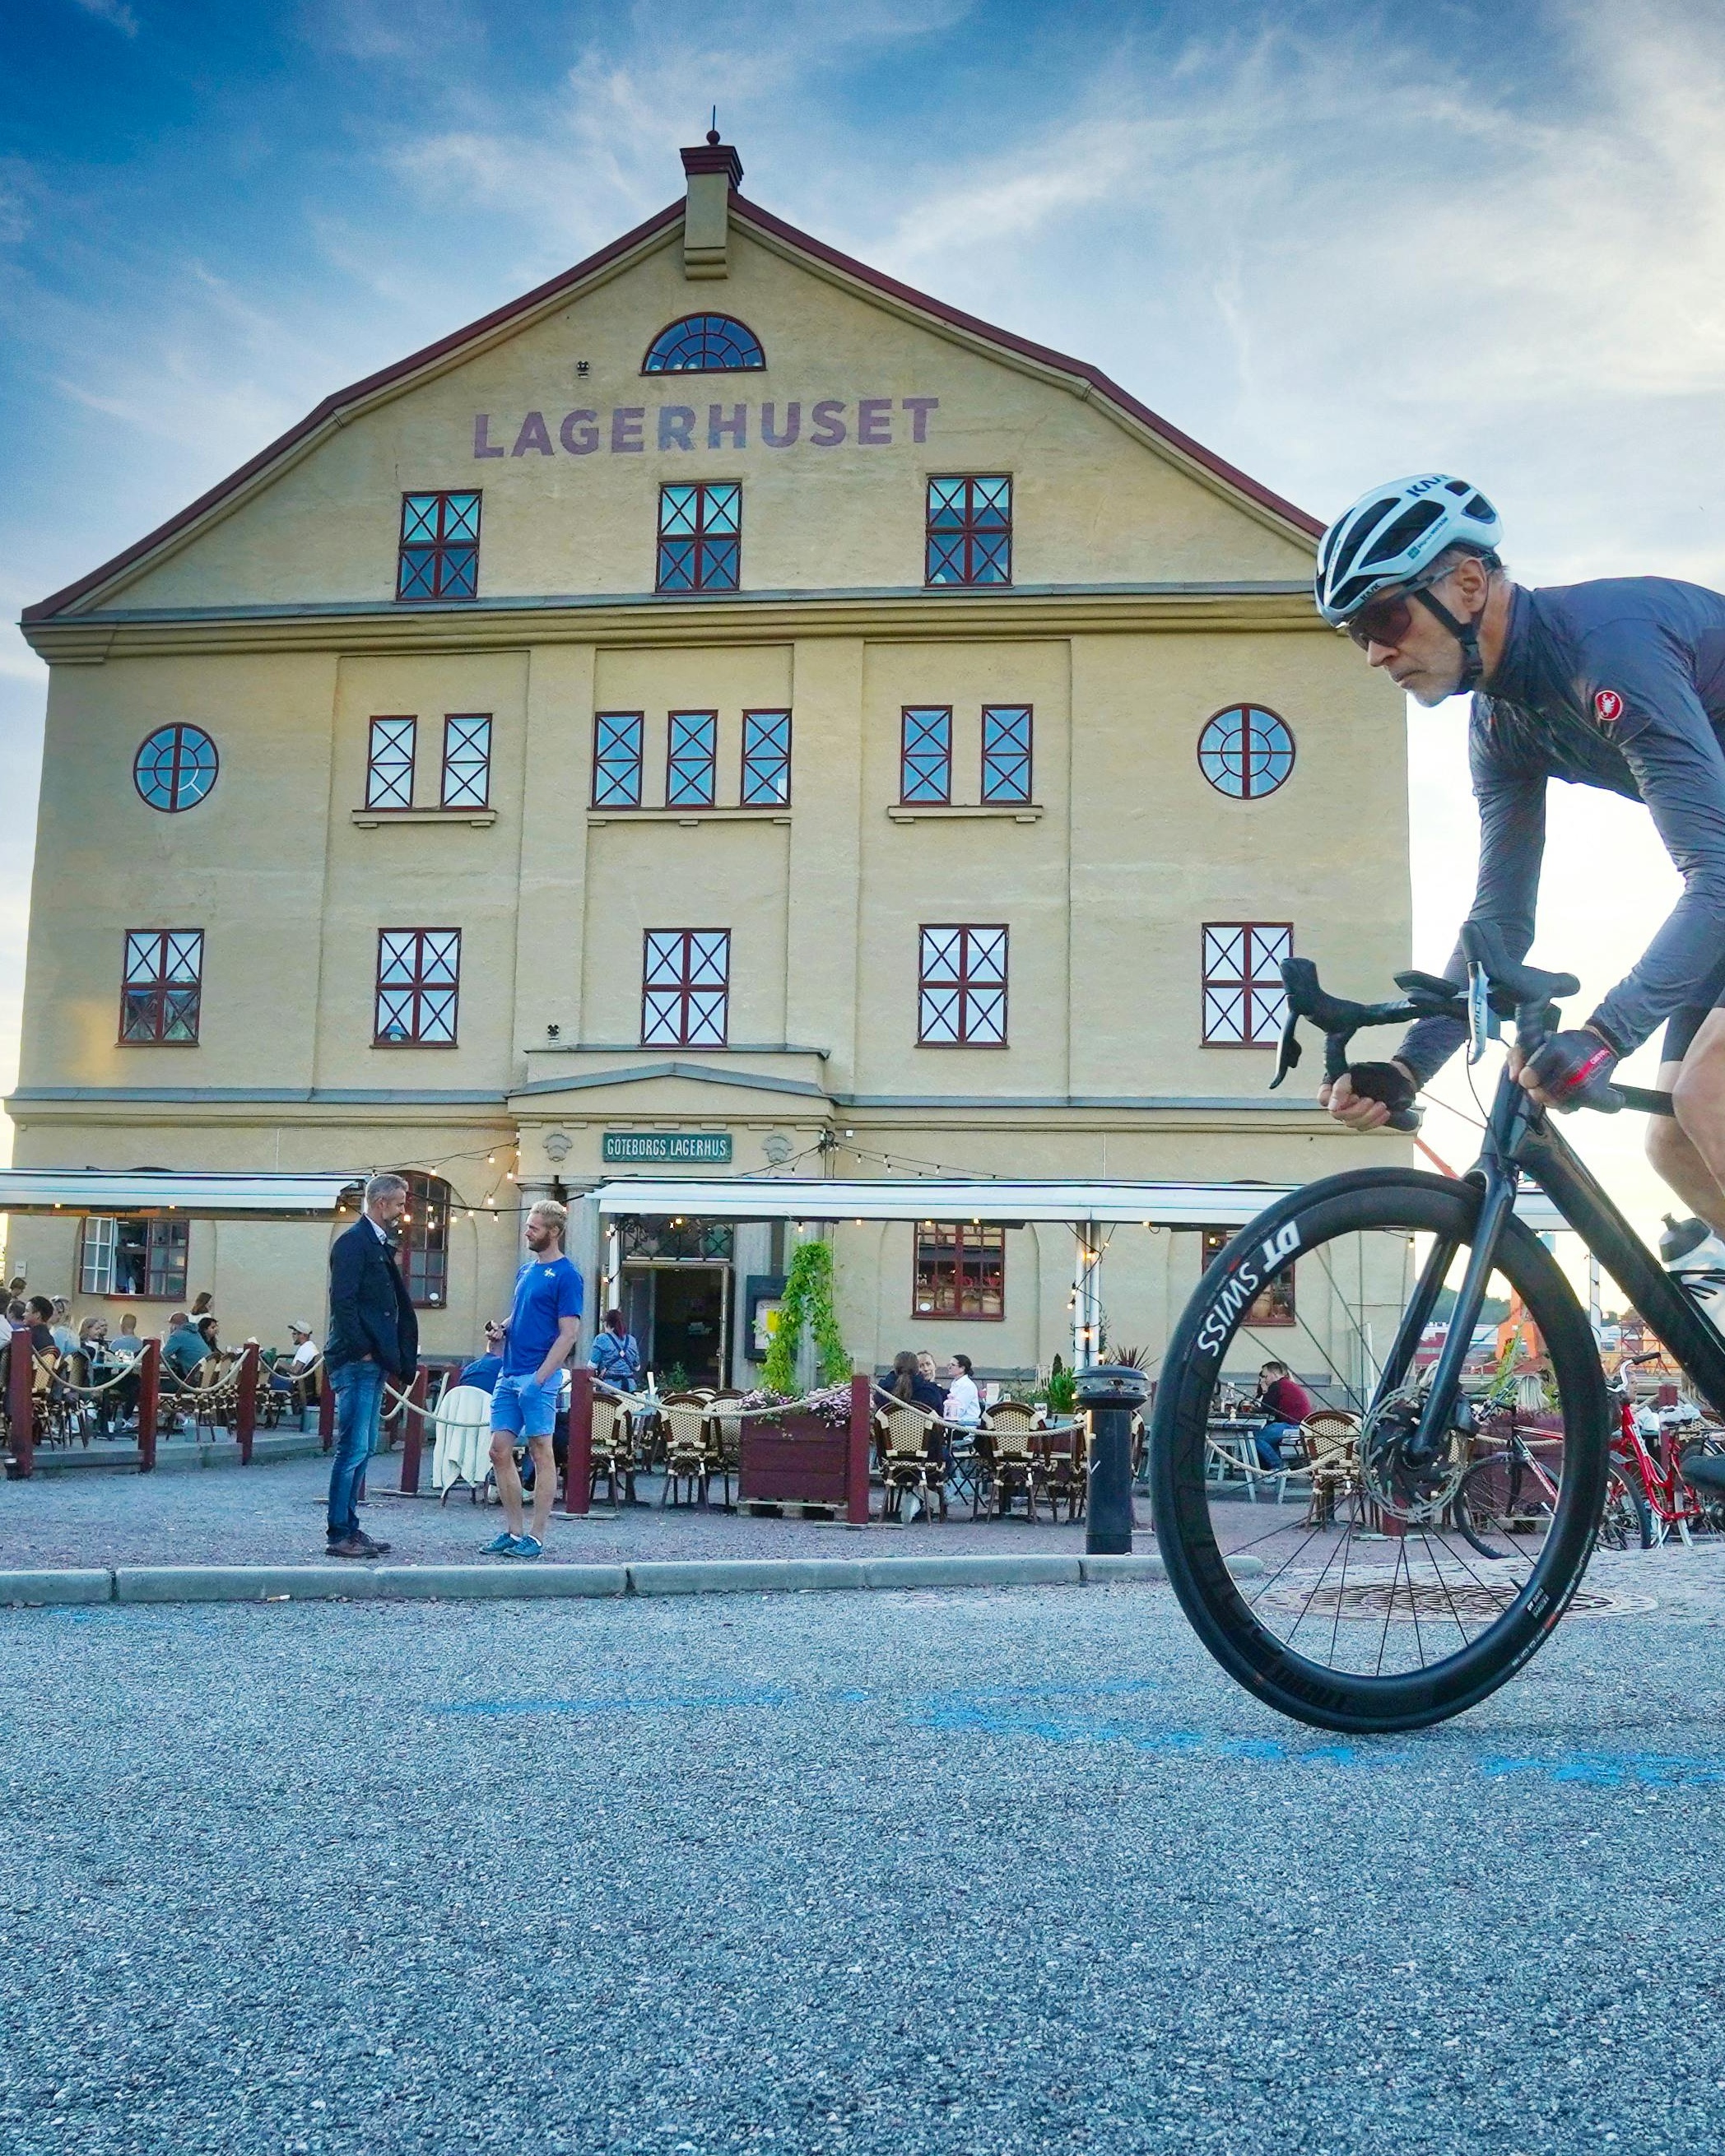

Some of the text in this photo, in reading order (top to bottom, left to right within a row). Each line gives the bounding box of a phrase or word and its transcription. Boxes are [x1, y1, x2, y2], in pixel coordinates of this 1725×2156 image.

[474, 397, 939, 458] LAGERHUSET
[607, 1136, 727, 1157] GÖTEBORGS LAGERHUS
[1197, 1220, 1302, 1357] DT SWISS
